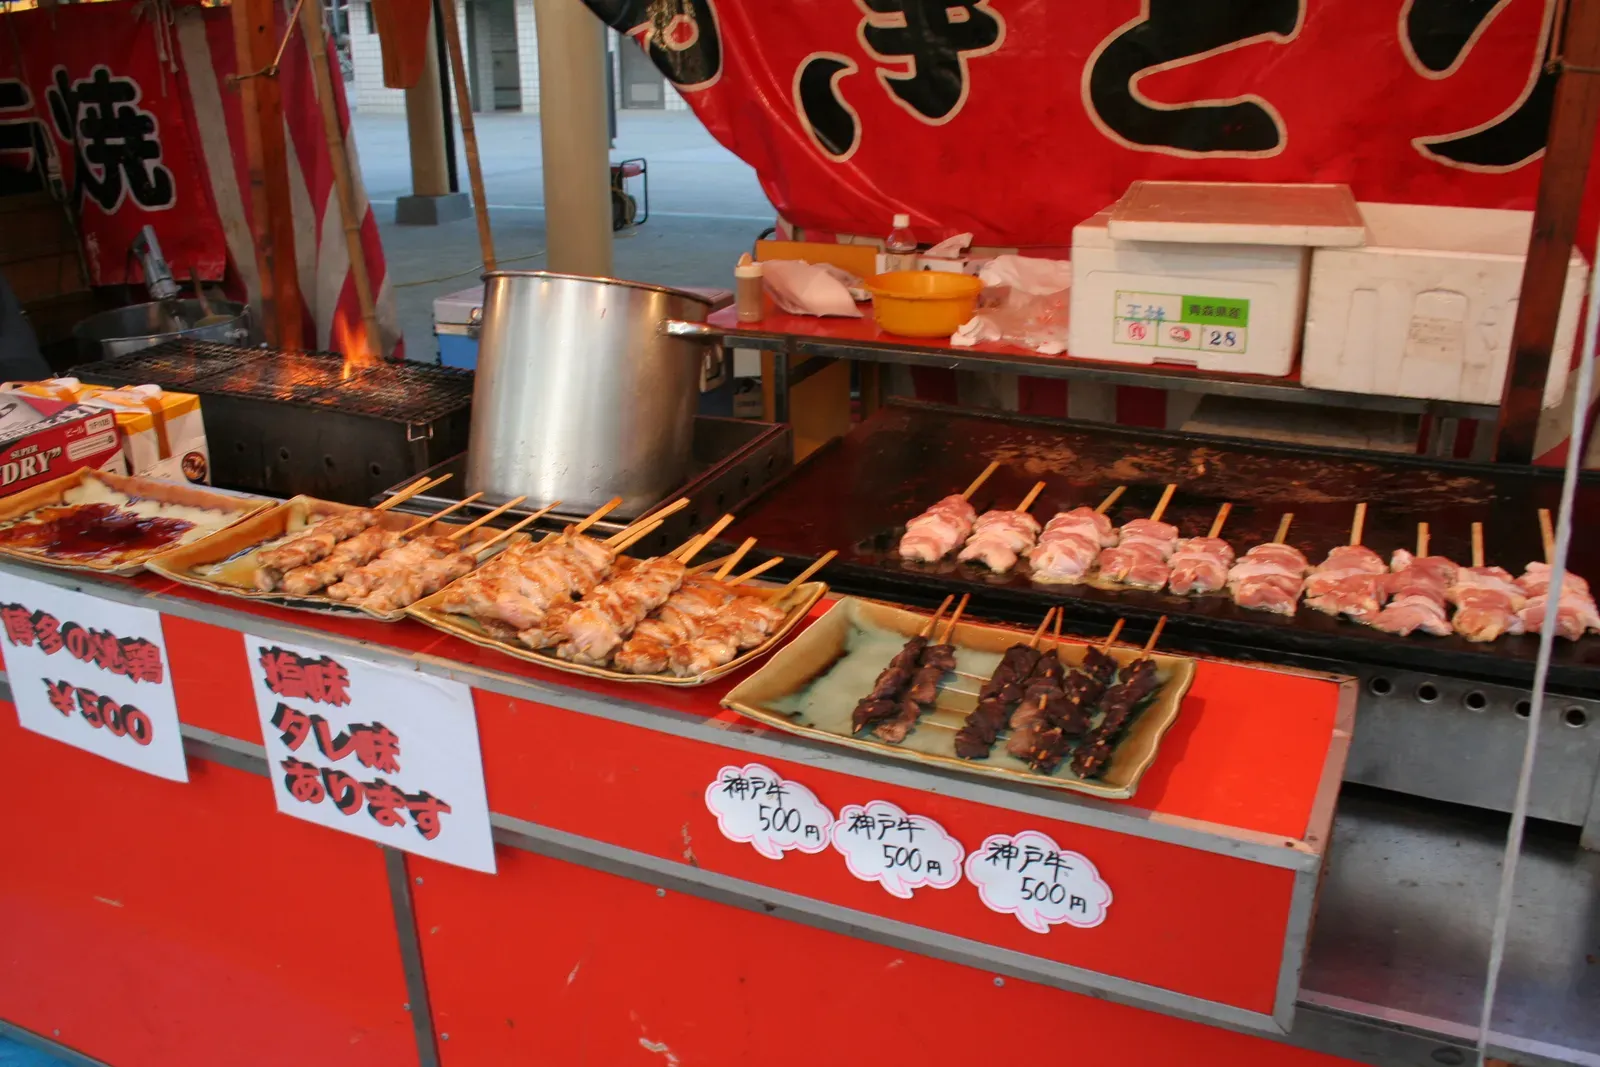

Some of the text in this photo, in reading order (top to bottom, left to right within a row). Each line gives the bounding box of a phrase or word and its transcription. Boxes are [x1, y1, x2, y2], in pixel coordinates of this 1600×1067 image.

[1209, 330, 1237, 347] 28
[10, 444, 38, 460] SUPER
[0, 601, 164, 685] 博多の地鶏
[258, 645, 352, 708] 塩味
[41, 677, 153, 746] ¥500
[270, 702, 401, 774] タレ味
[280, 755, 452, 841] あります
[722, 774, 790, 807] 神戸牛
[758, 806, 820, 842] 500円
[848, 812, 927, 843] 神戸牛
[883, 844, 942, 877] 500円
[984, 841, 1074, 883] 神戸牛
[1020, 877, 1087, 914] 500円
